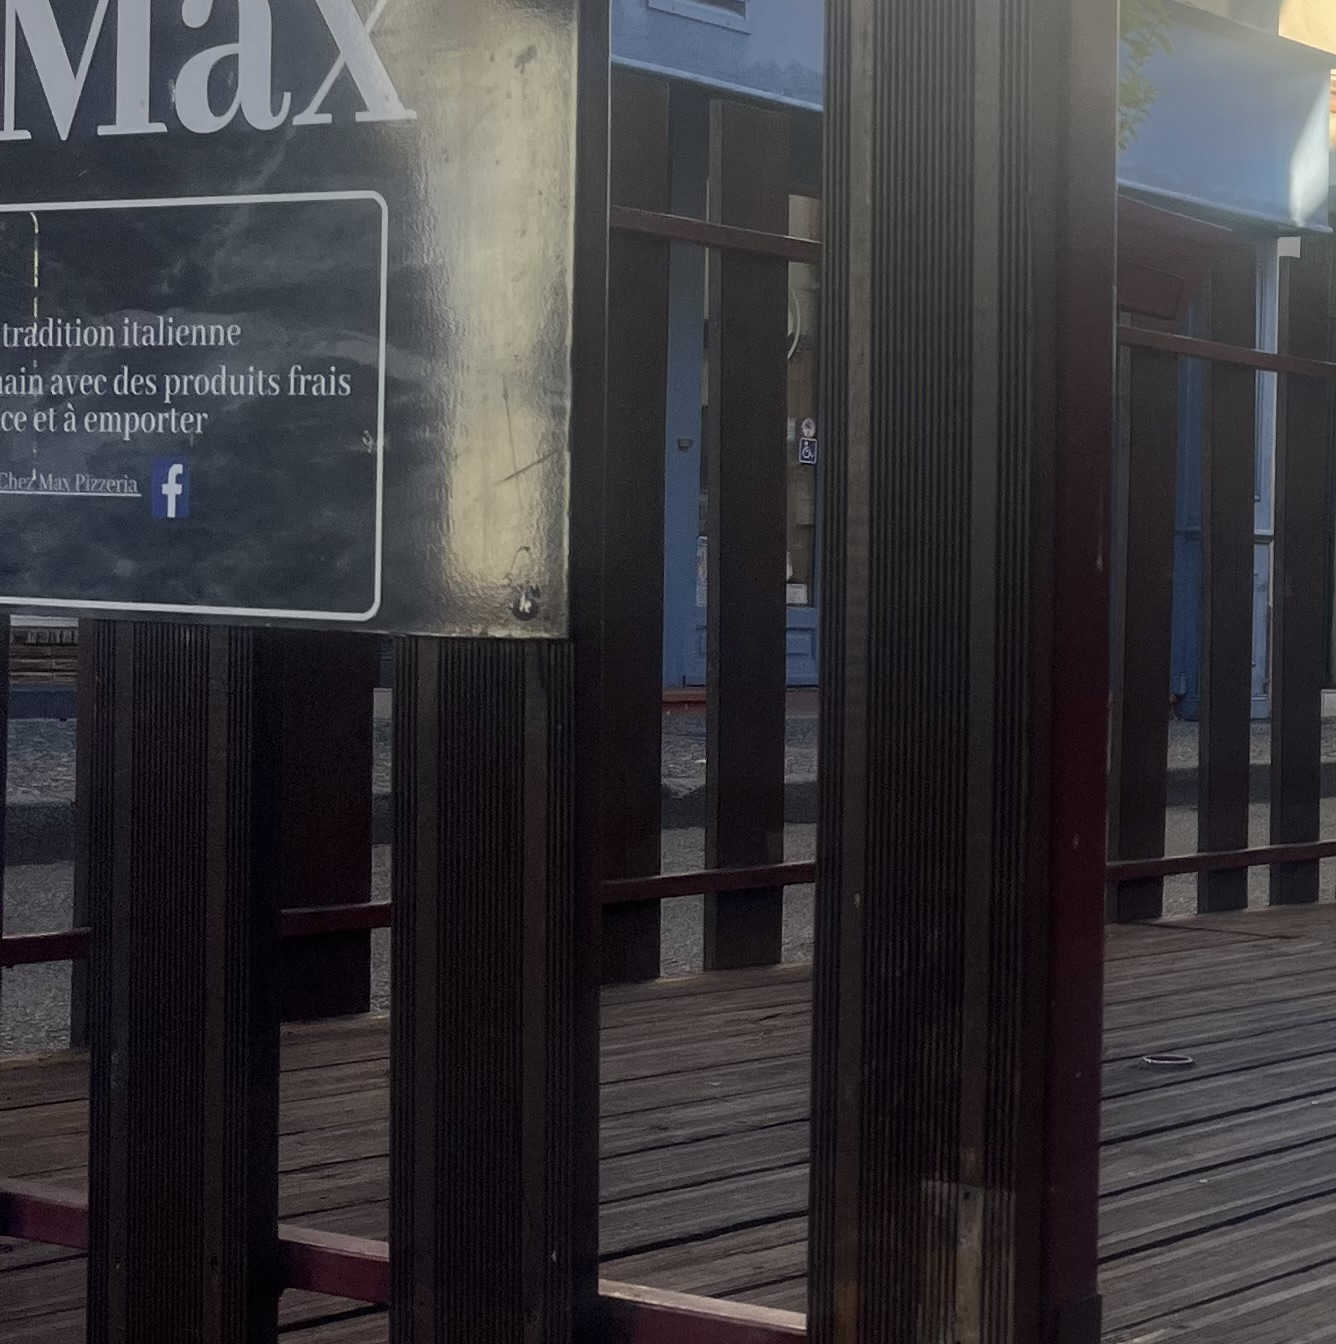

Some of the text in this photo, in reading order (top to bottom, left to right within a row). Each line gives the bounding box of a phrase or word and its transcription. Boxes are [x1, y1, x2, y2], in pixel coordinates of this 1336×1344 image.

[3, 315, 242, 348] tradition italienne
[0, 364, 352, 404] ain avec des produits frais
[0, 402, 209, 441] ce et à emporter
[0, 470, 139, 494] Chez Max Pizzeria
